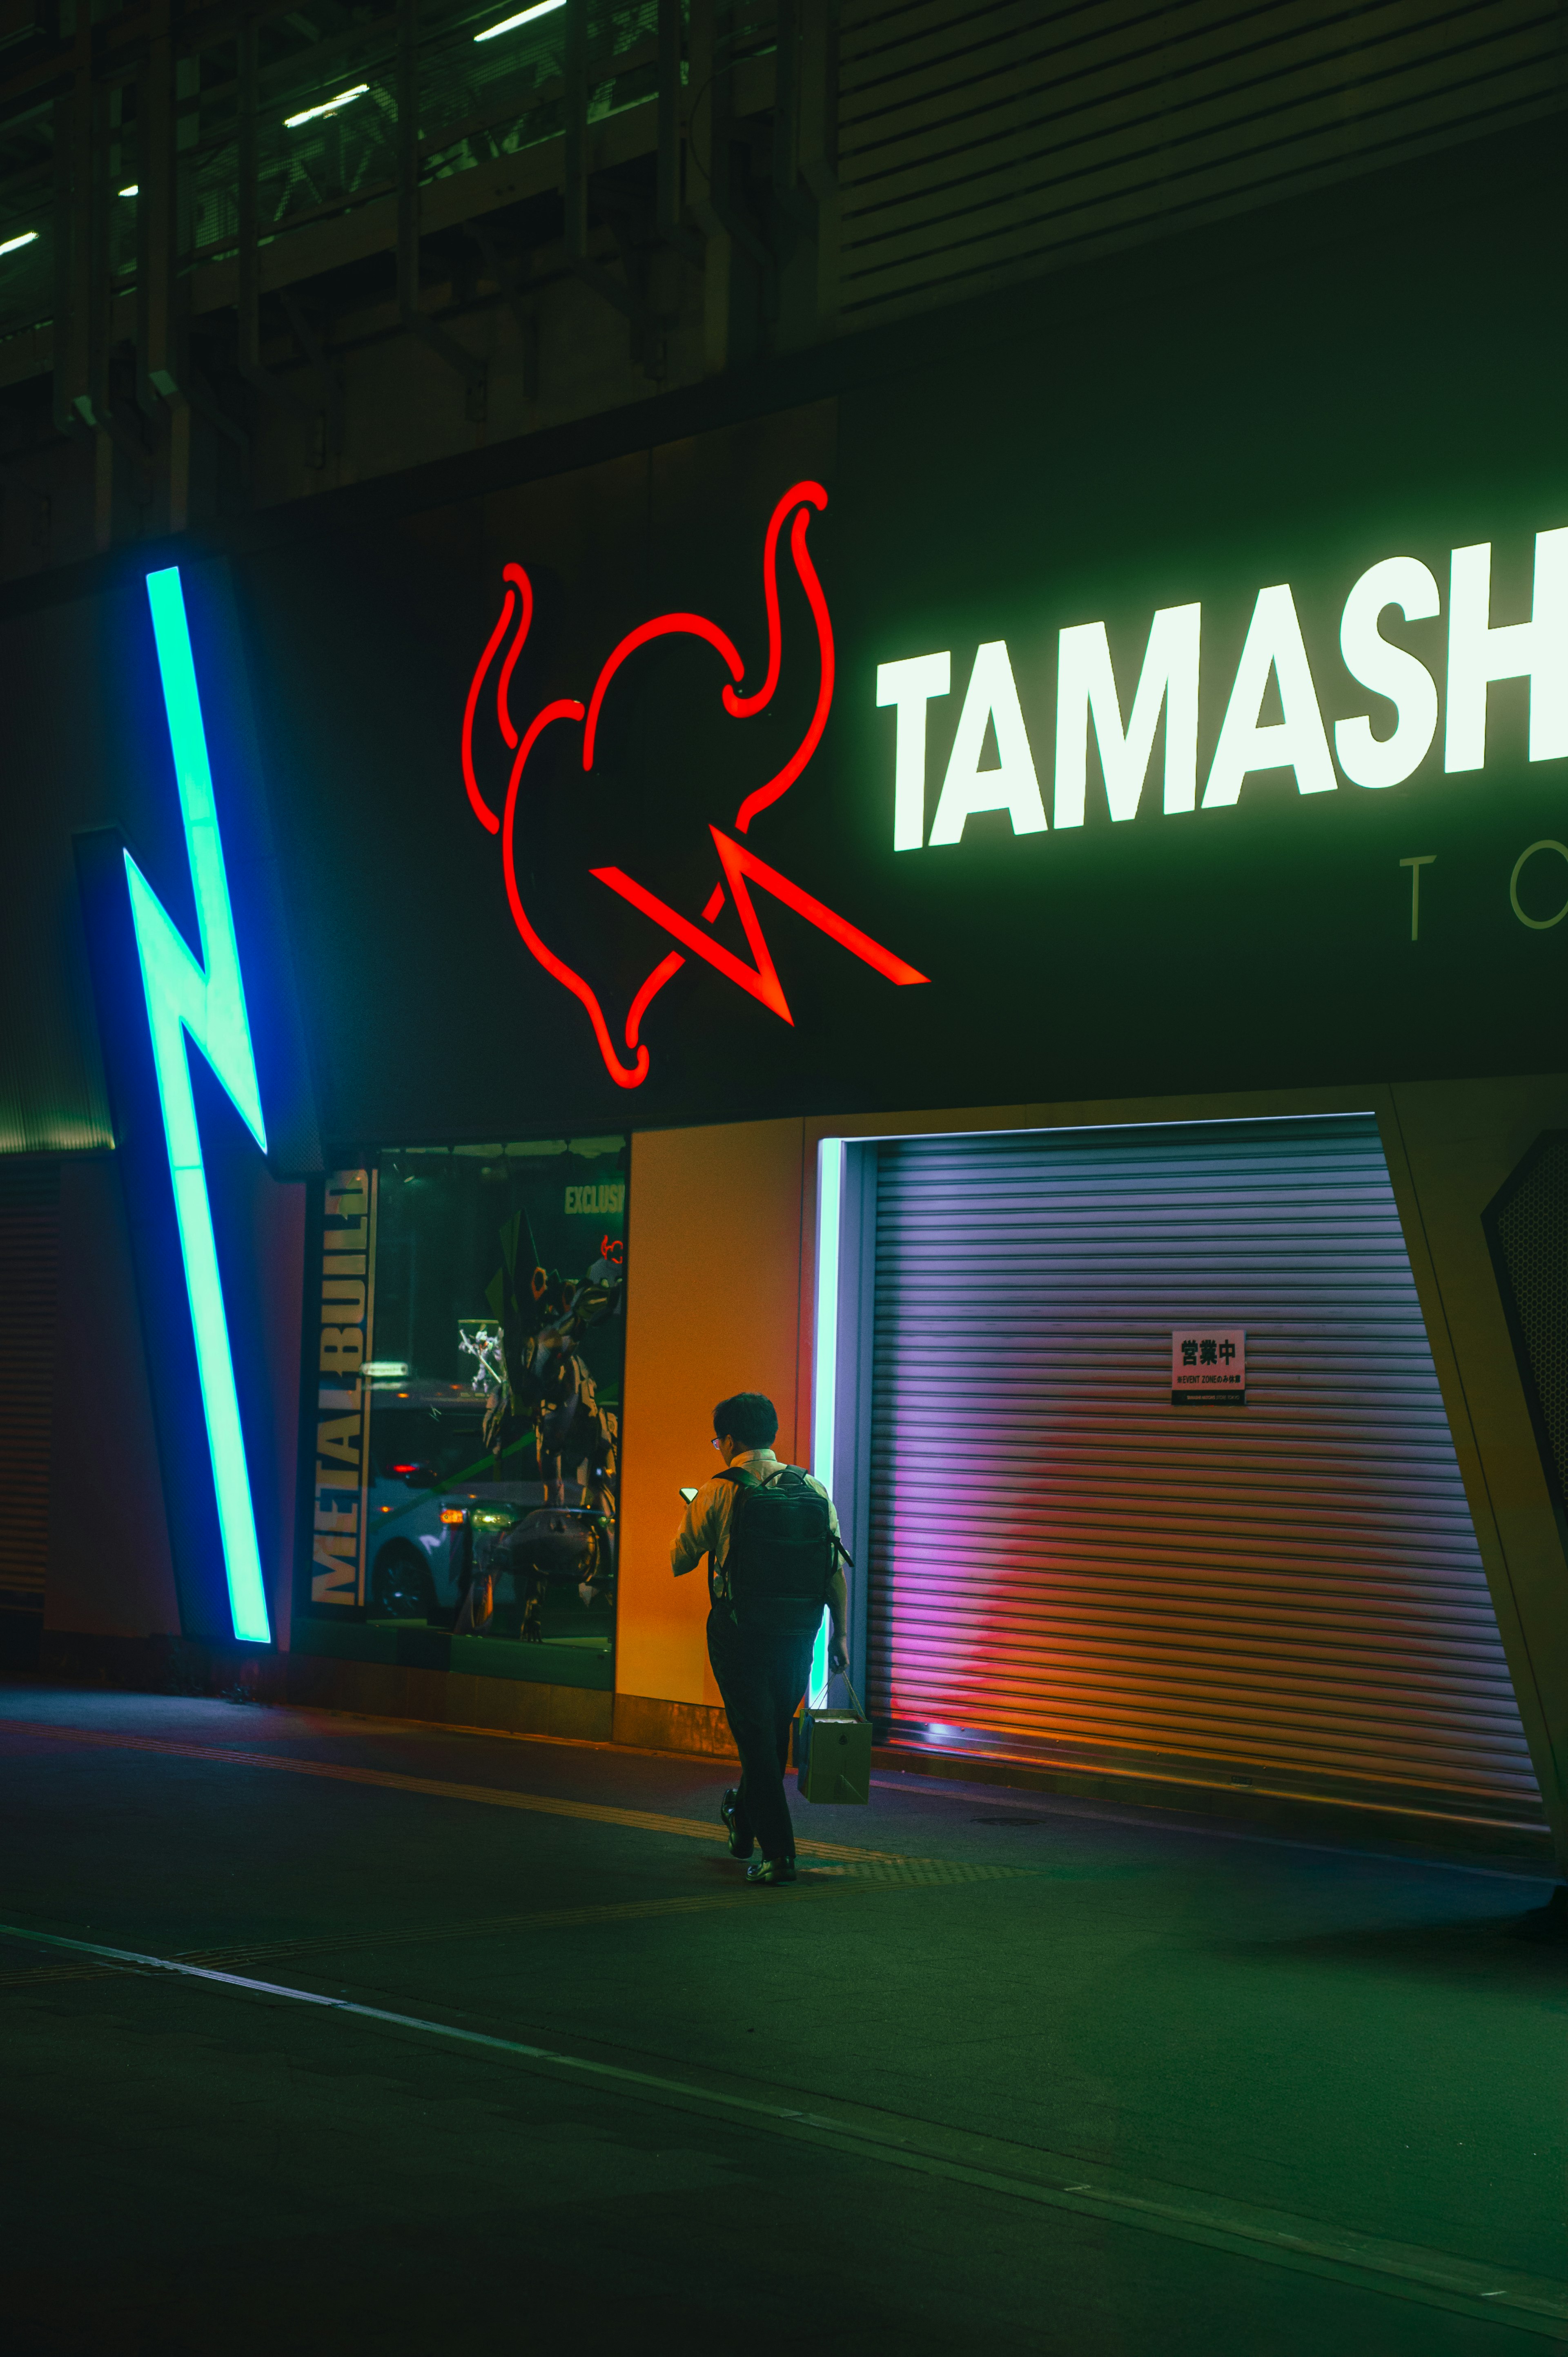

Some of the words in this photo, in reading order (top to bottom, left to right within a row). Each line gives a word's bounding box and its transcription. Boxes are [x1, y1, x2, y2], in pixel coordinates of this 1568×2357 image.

[876, 526, 1568, 852] TAMASH
[1399, 839, 1568, 941] TO
[564, 1184, 626, 1215] EXCLUSI
[1181, 1339, 1236, 1366] 営業中
